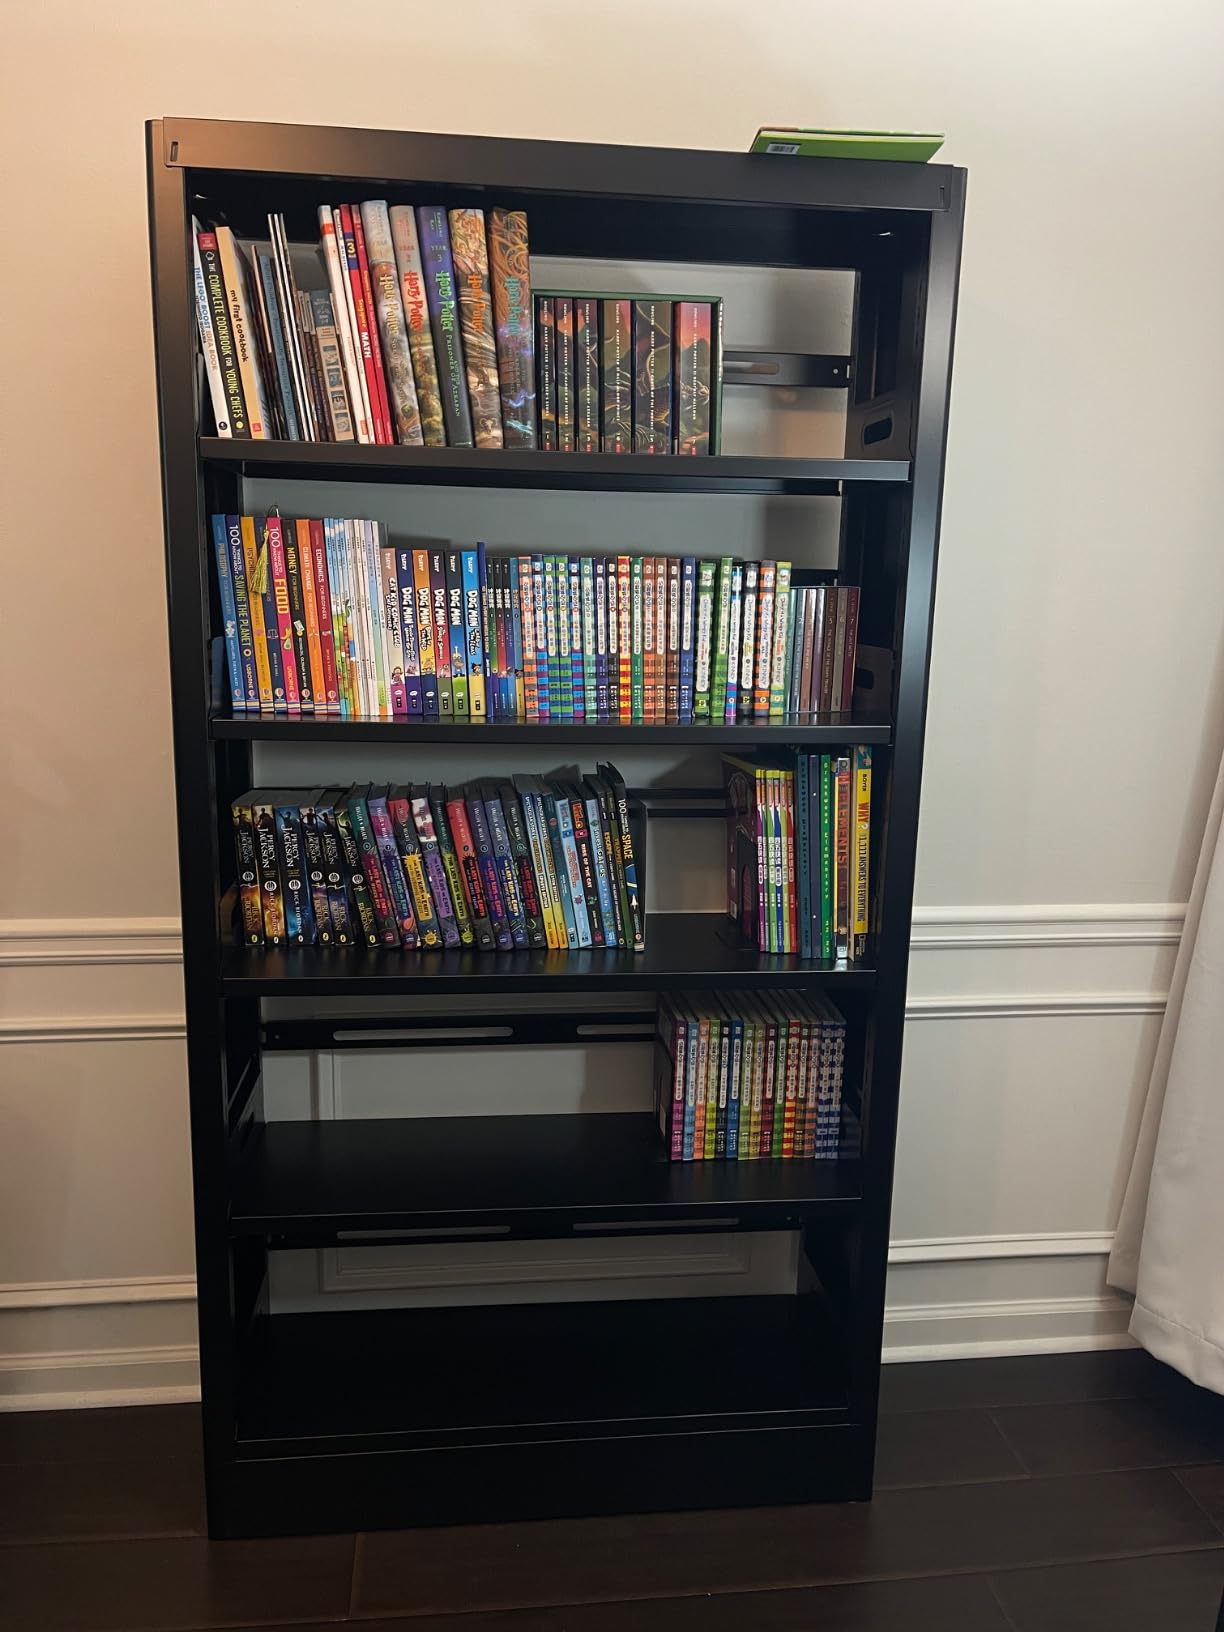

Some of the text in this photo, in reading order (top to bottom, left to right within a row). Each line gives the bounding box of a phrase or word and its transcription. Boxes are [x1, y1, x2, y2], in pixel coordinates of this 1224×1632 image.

[209, 274, 225, 313] COMPLETE
[403, 272, 422, 299] Harry
[407, 300, 427, 331] Potter
[434, 271, 458, 331] Harry Potter
[467, 275, 489, 333] Harry Potter
[201, 305, 210, 329] BOOST
[230, 290, 249, 362] my first cookbook
[206, 331, 214, 347] IDEA
[216, 316, 232, 355] COOKBOOK
[360, 332, 372, 358] MATH
[209, 349, 218, 370] BOOK
[225, 369, 239, 394] YOUNG
[445, 334, 456, 371] PRISONER
[452, 384, 462, 417] AZKABAN
[230, 397, 244, 417] CHEFS
[229, 525, 240, 546] 100
[269, 527, 281, 548] 100
[286, 547, 298, 574] MONEY
[315, 549, 324, 583] ECONOMICS
[274, 578, 289, 614] FOOD
[389, 577, 397, 591] CAT
[401, 587, 413, 606] DOG
[234, 575, 251, 646] SAVING THE PLANET
[402, 606, 415, 624] MAN
[417, 588, 431, 625] DOG MAN
[433, 589, 447, 626] DOG MAN
[449, 589, 462, 626] DOG MAN
[466, 590, 479, 627] DOG MAN
[286, 666, 294, 691] USBORNE
[618, 799, 627, 814] 100
[239, 830, 250, 864] JACKSON
[258, 829, 272, 868] JACKSON
[267, 835, 275, 861] PERCY
[281, 824, 296, 867] JACKSON
[291, 834, 300, 860] PERCY
[306, 831, 318, 864] JACKSON
[323, 832, 335, 864] JACKSON
[343, 836, 357, 867] JACKSON
[621, 835, 633, 860] SPACE
[858, 857, 866, 882] ANSWERS
[414, 867, 431, 916] LAST KIDS EARTH
[507, 880, 515, 893] KIDS
[511, 900, 520, 916] EARTH
[857, 890, 865, 922] EVERYTHING
[331, 902, 342, 931] RIORDAN
[357, 903, 371, 932] RIORDAN
[457, 901, 466, 917] EARTH
[477, 900, 486, 916] EARTH
[494, 900, 503, 917] EARTH
